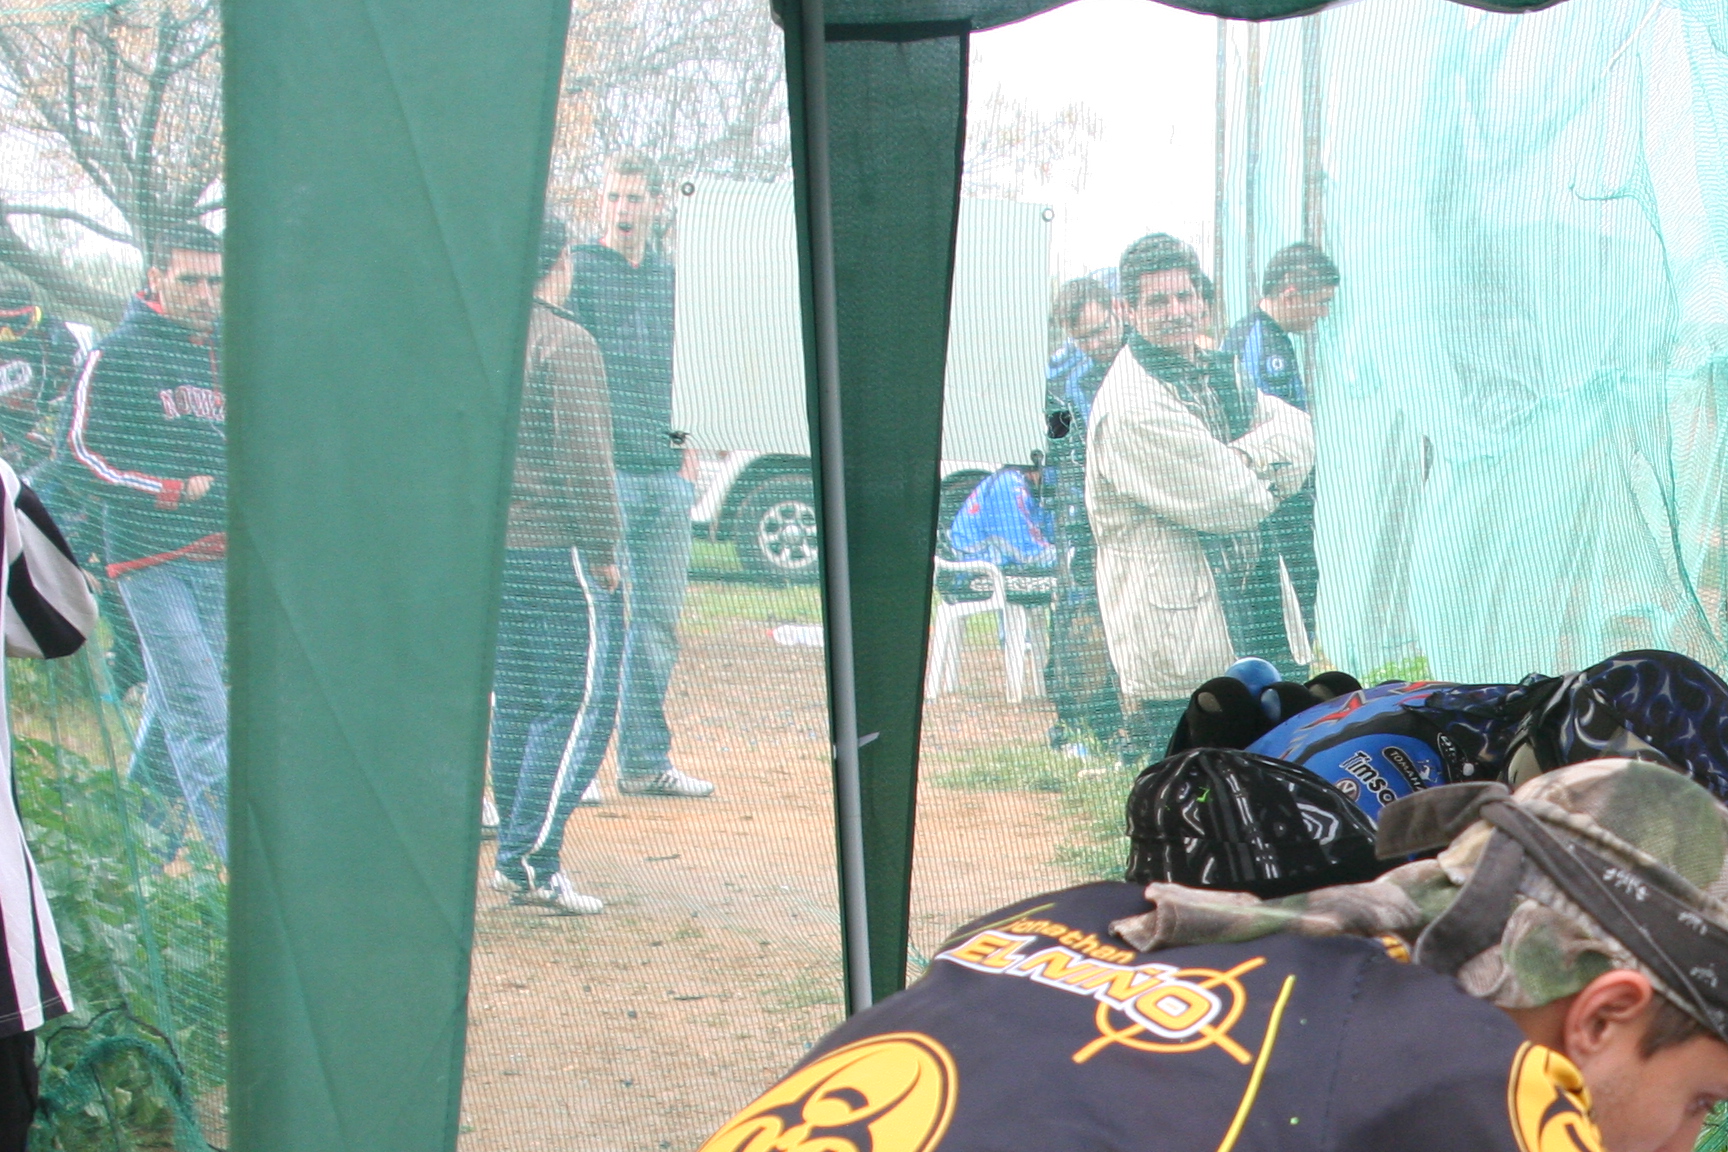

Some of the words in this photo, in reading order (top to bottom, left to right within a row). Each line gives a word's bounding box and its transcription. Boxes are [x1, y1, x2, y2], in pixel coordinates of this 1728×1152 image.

[1339, 750, 1399, 806] Timso
[938, 931, 1033, 972] EL
[998, 917, 1137, 964] jonathan
